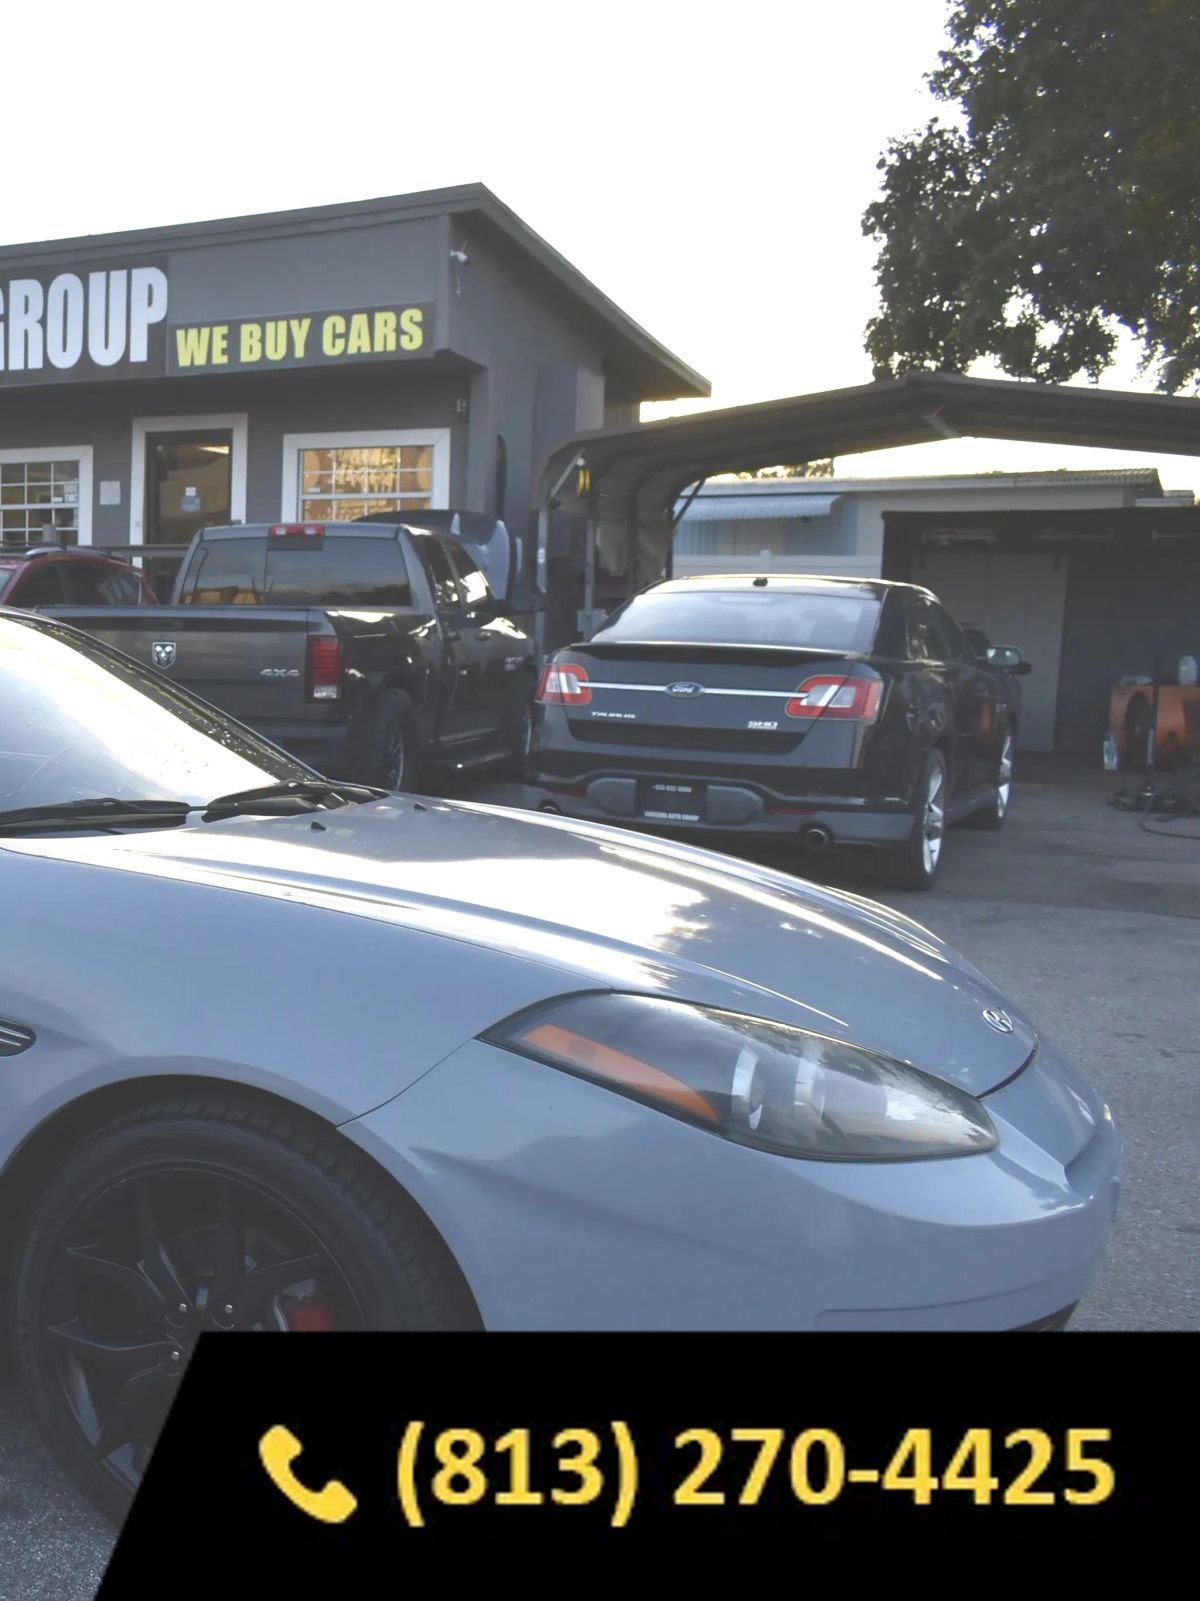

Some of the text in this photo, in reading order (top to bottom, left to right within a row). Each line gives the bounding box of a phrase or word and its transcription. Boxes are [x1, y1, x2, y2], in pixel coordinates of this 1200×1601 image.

[175, 307, 424, 368] WE BUY CARS
